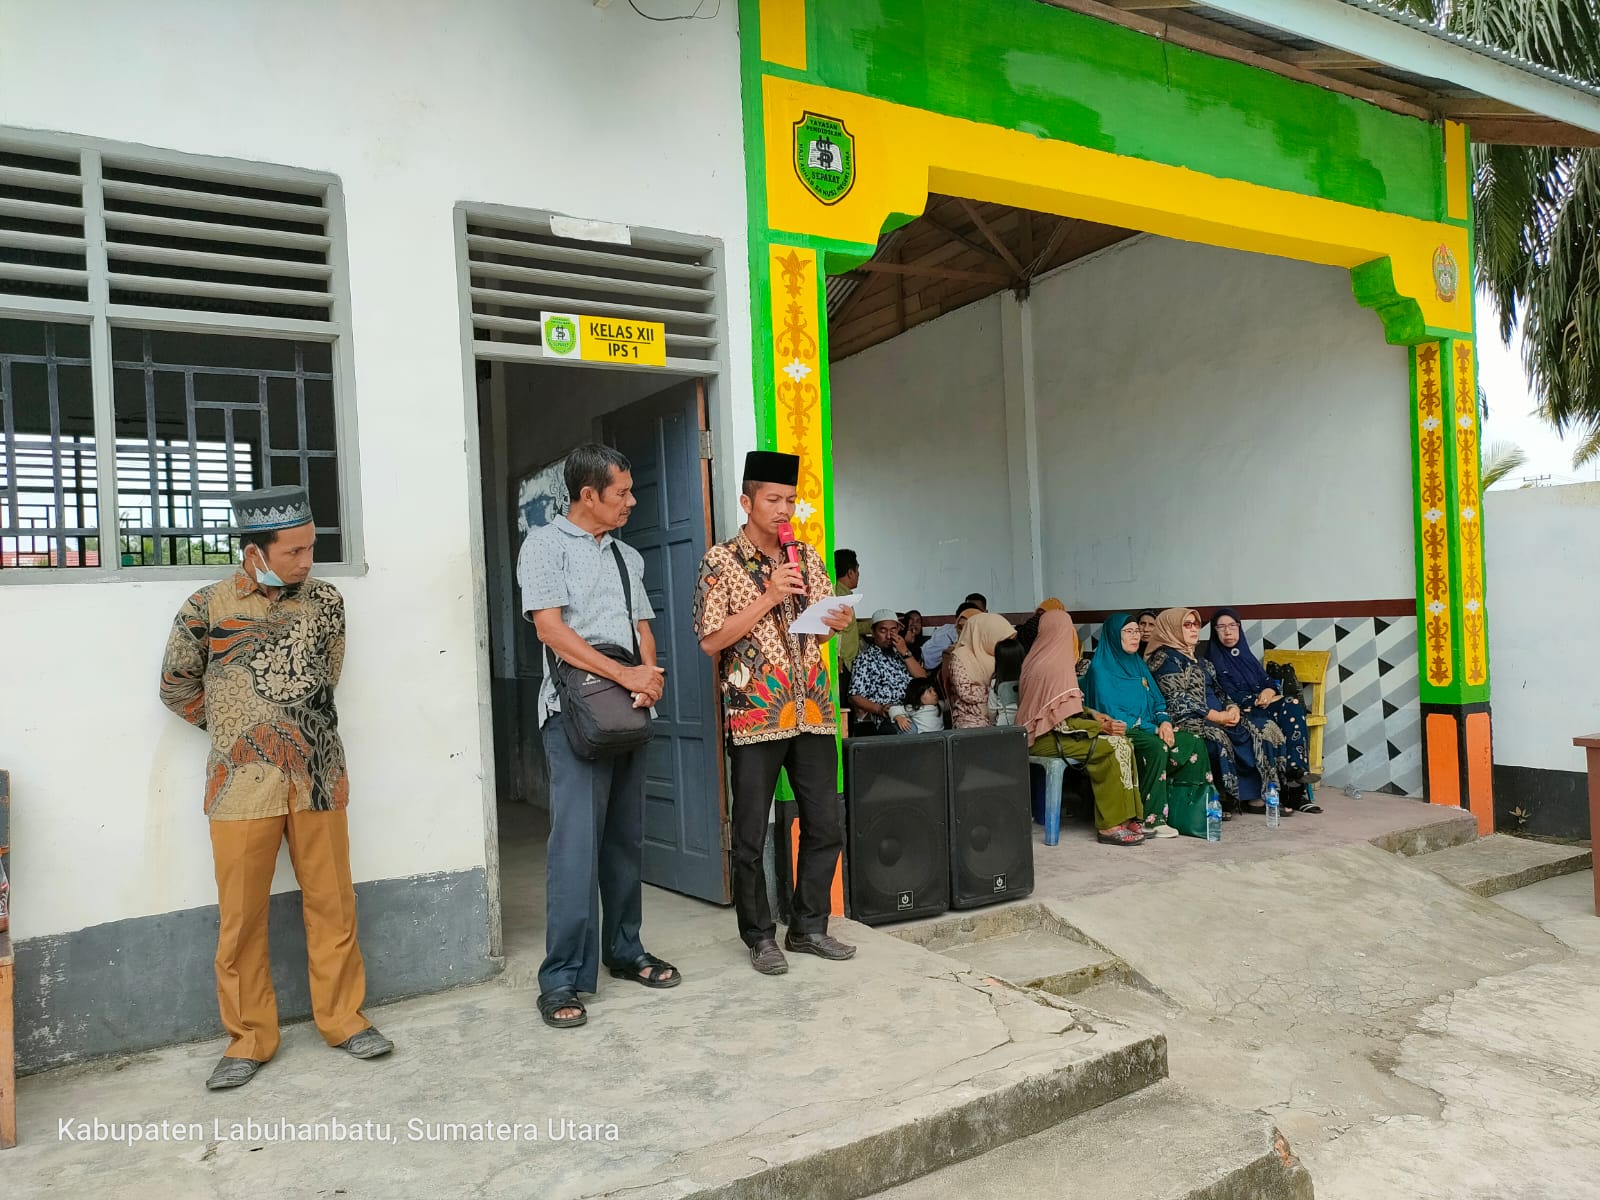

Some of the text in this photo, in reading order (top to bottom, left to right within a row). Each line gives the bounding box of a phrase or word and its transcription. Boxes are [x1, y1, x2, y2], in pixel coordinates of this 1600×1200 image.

[810, 119, 838, 130] YAYASAN
[811, 171, 840, 184] SEPAKAT
[590, 322, 654, 342] KELAS XII
[608, 342, 638, 358] IPS 1
